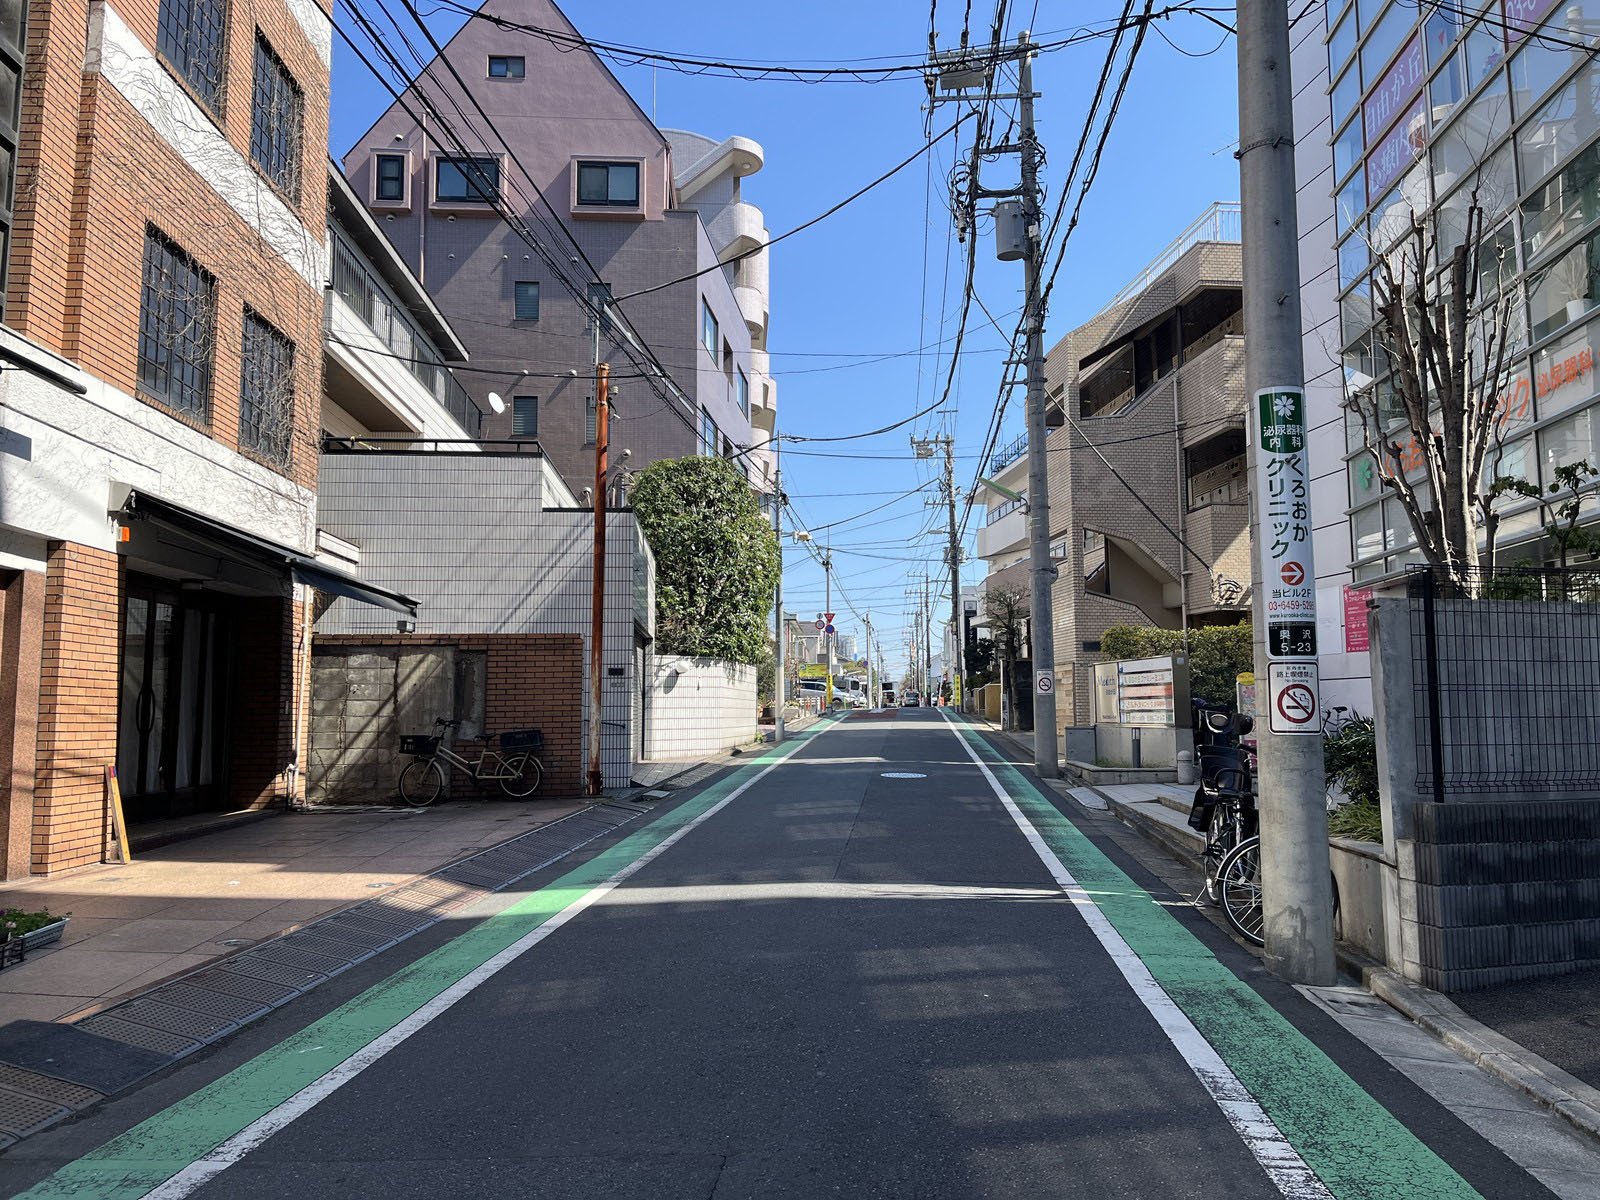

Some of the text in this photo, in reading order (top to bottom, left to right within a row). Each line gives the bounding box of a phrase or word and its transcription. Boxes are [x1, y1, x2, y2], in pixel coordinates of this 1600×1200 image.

[1366, 46, 1423, 139] 自由が丘
[1536, 347, 1593, 398] 泌尿器科
[1263, 424, 1304, 437] 泌尿器科
[1266, 457, 1290, 559] クリニック
[1291, 457, 1309, 543] くろおか
[1272, 588, 1312, 599] 当ビル2F
[1280, 642, 1311, 653] 5-23
